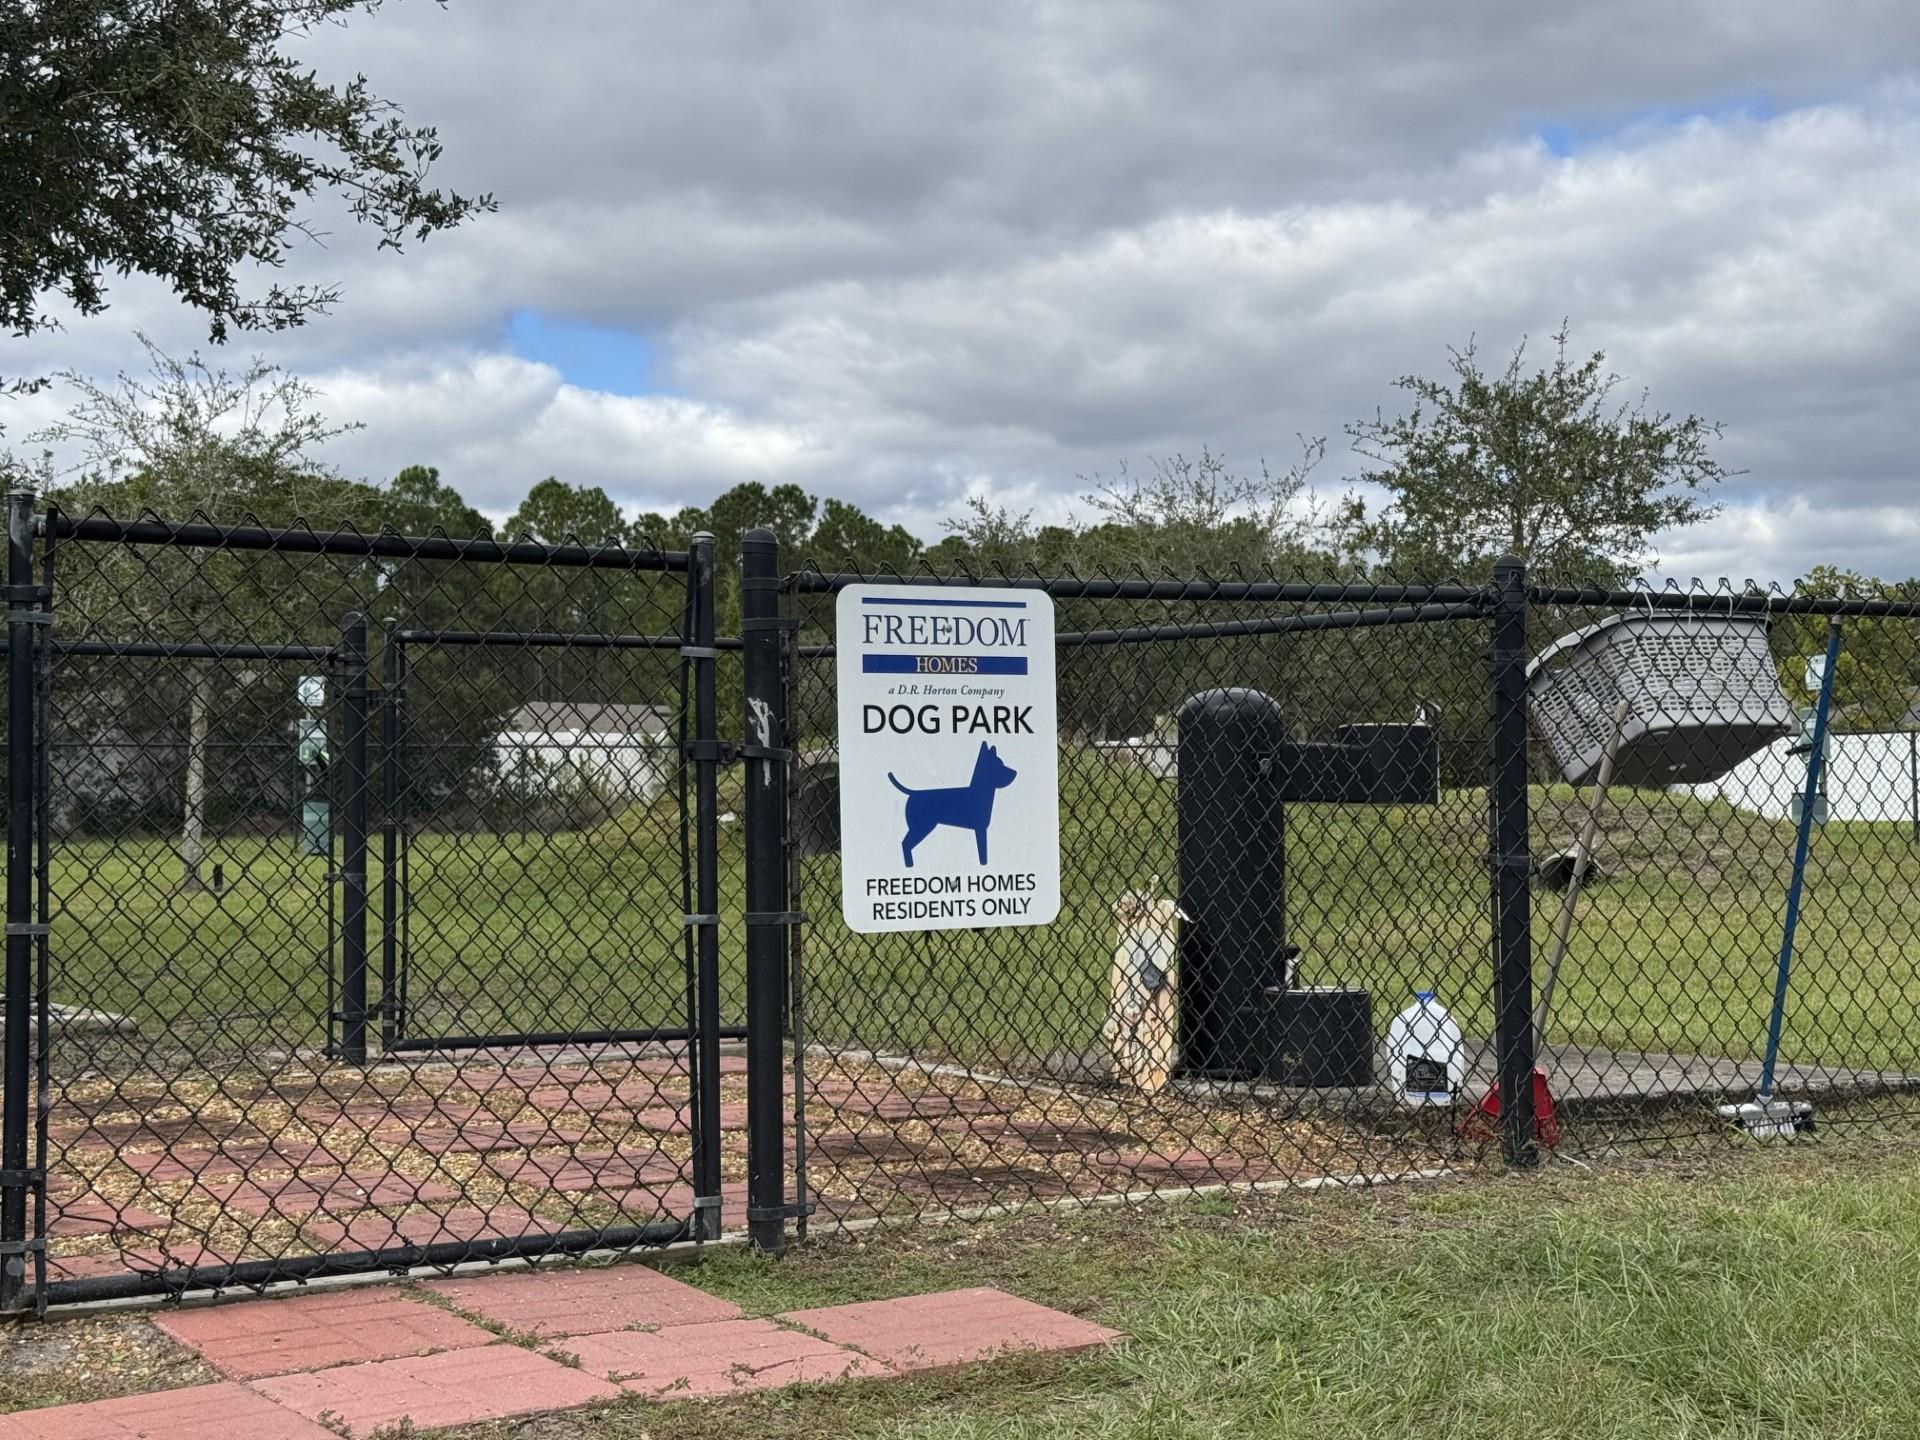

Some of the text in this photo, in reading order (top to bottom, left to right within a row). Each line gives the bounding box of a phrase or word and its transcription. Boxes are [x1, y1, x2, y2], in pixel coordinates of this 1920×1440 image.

[862, 614, 1028, 646] FREEDOM
[915, 656, 978, 673] HOMES
[888, 684, 1005, 698] a D.R. Horton Company
[863, 704, 1034, 734] DOG PARK
[866, 873, 1036, 896] FREEDOM HOMES
[873, 897, 1032, 920] RESIDENTS ONLY
